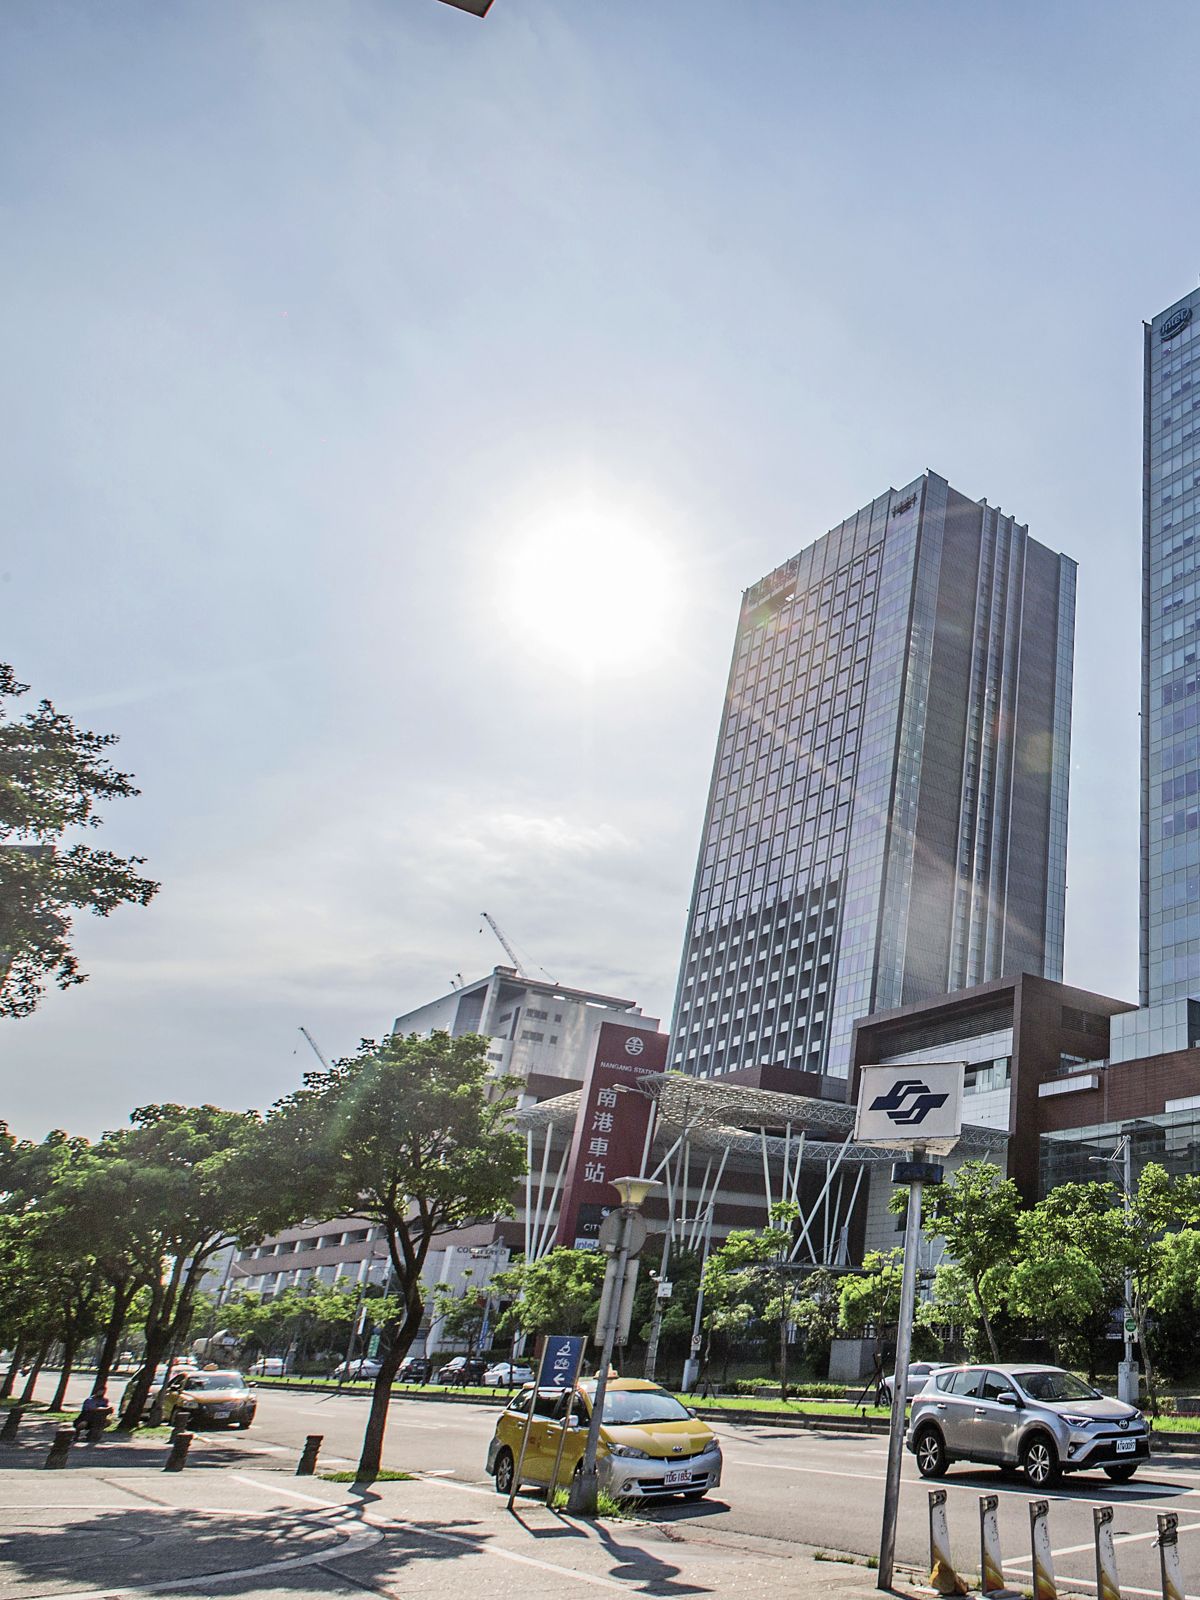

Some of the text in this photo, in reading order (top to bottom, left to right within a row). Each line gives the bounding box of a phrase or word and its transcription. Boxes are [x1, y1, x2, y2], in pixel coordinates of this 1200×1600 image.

[601, 1061, 632, 1072] NANGANG
[584, 1087, 617, 1184] 南港車站
[457, 1246, 506, 1255] COTYAD
